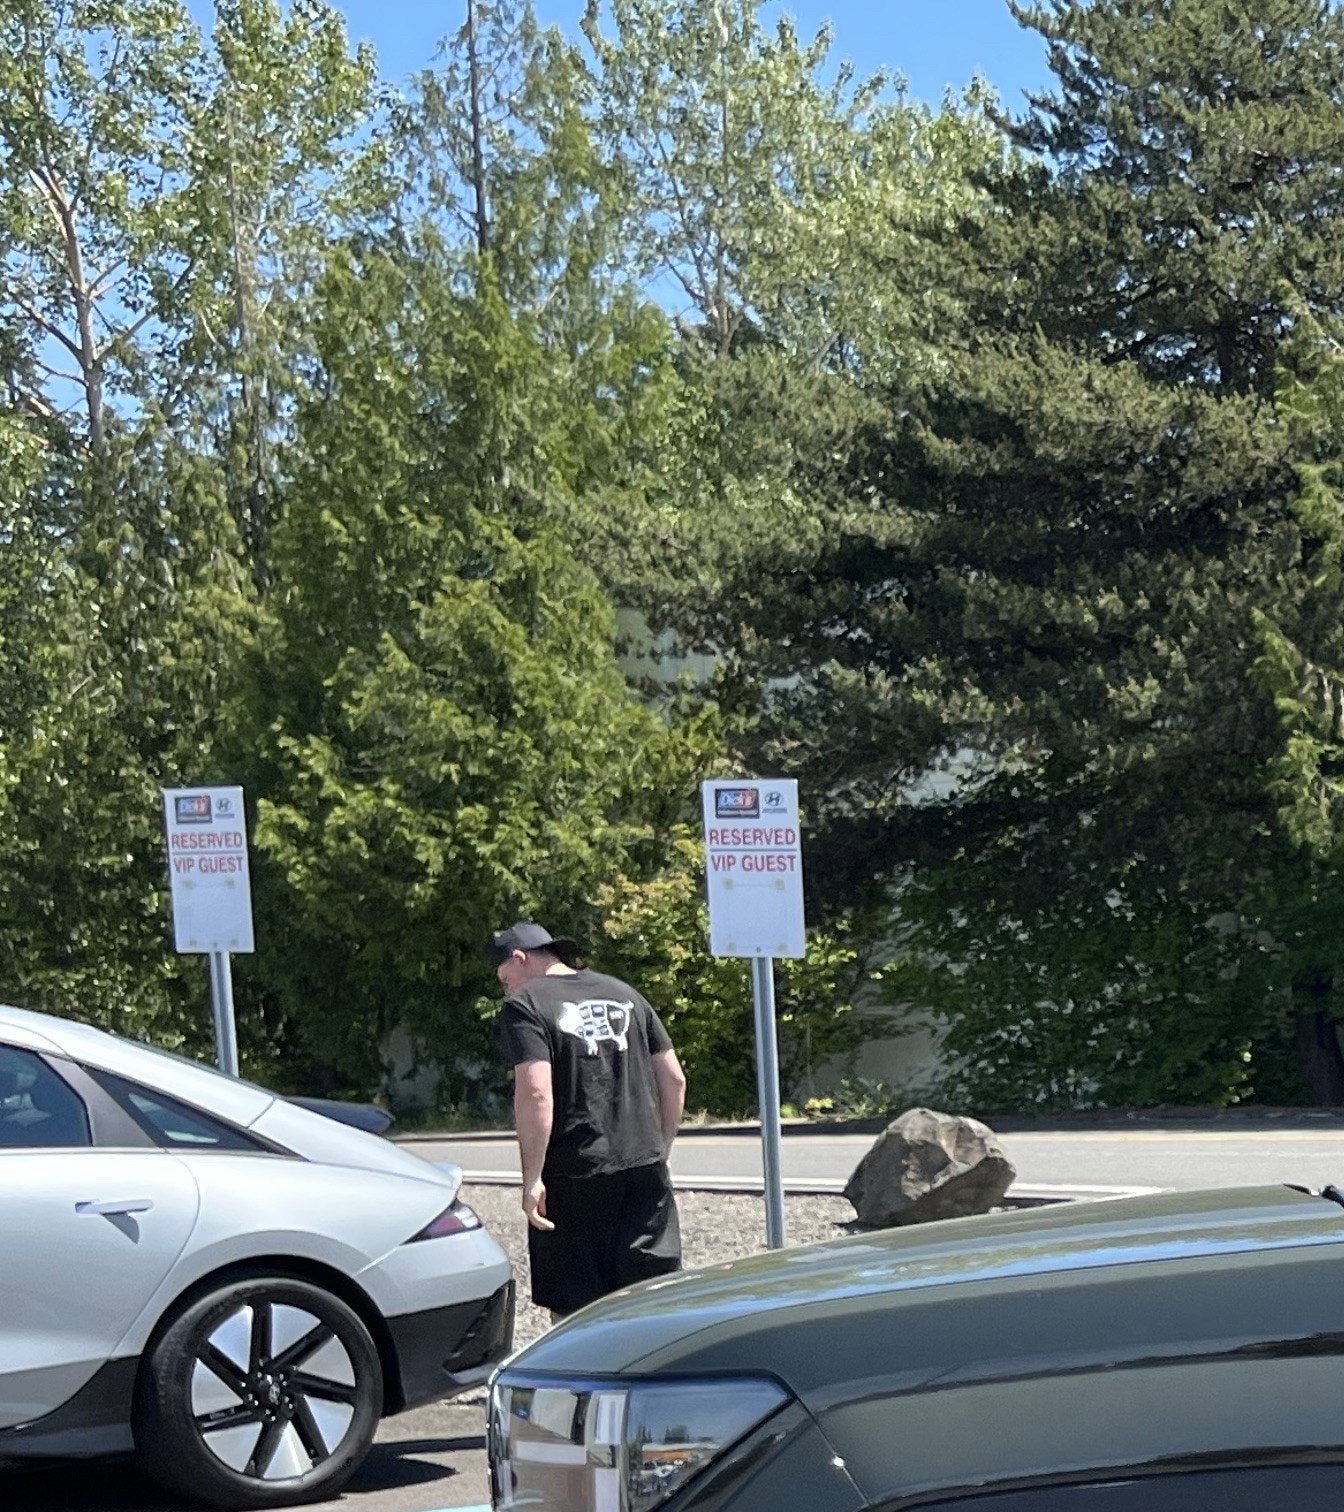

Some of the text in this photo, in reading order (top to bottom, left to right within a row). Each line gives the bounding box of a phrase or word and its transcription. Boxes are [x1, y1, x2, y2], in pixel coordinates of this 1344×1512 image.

[172, 832, 243, 849] RESERVED
[709, 828, 796, 846] RESERVED
[174, 855, 244, 873] VIP GUEST
[711, 854, 796, 872] VIP GUEST
